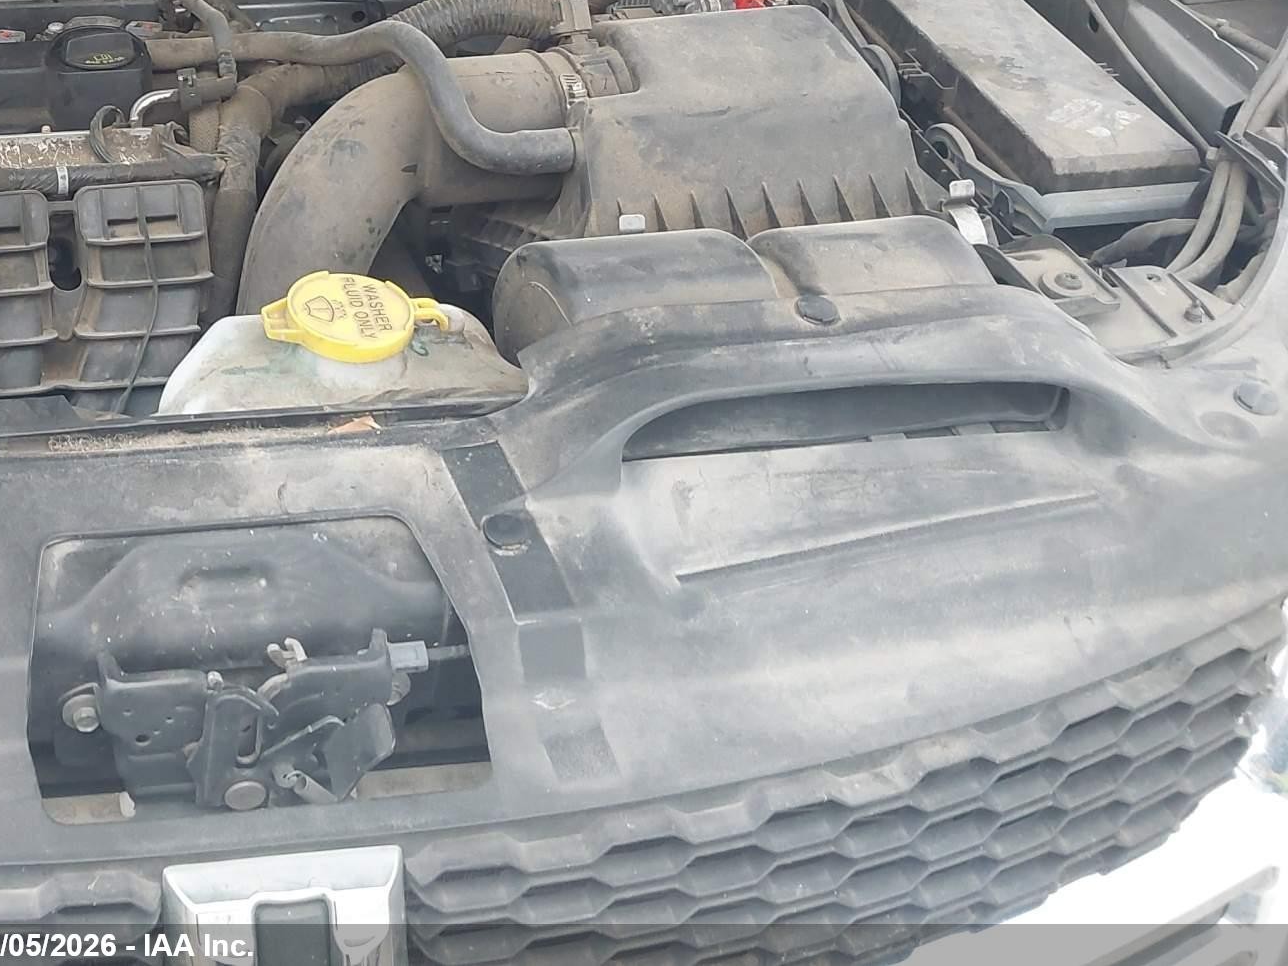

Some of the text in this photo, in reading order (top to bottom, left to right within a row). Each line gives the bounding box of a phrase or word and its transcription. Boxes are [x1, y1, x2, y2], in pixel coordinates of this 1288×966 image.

[344, 278, 377, 339] FLUID ONLY
[365, 284, 392, 331] WASHER
